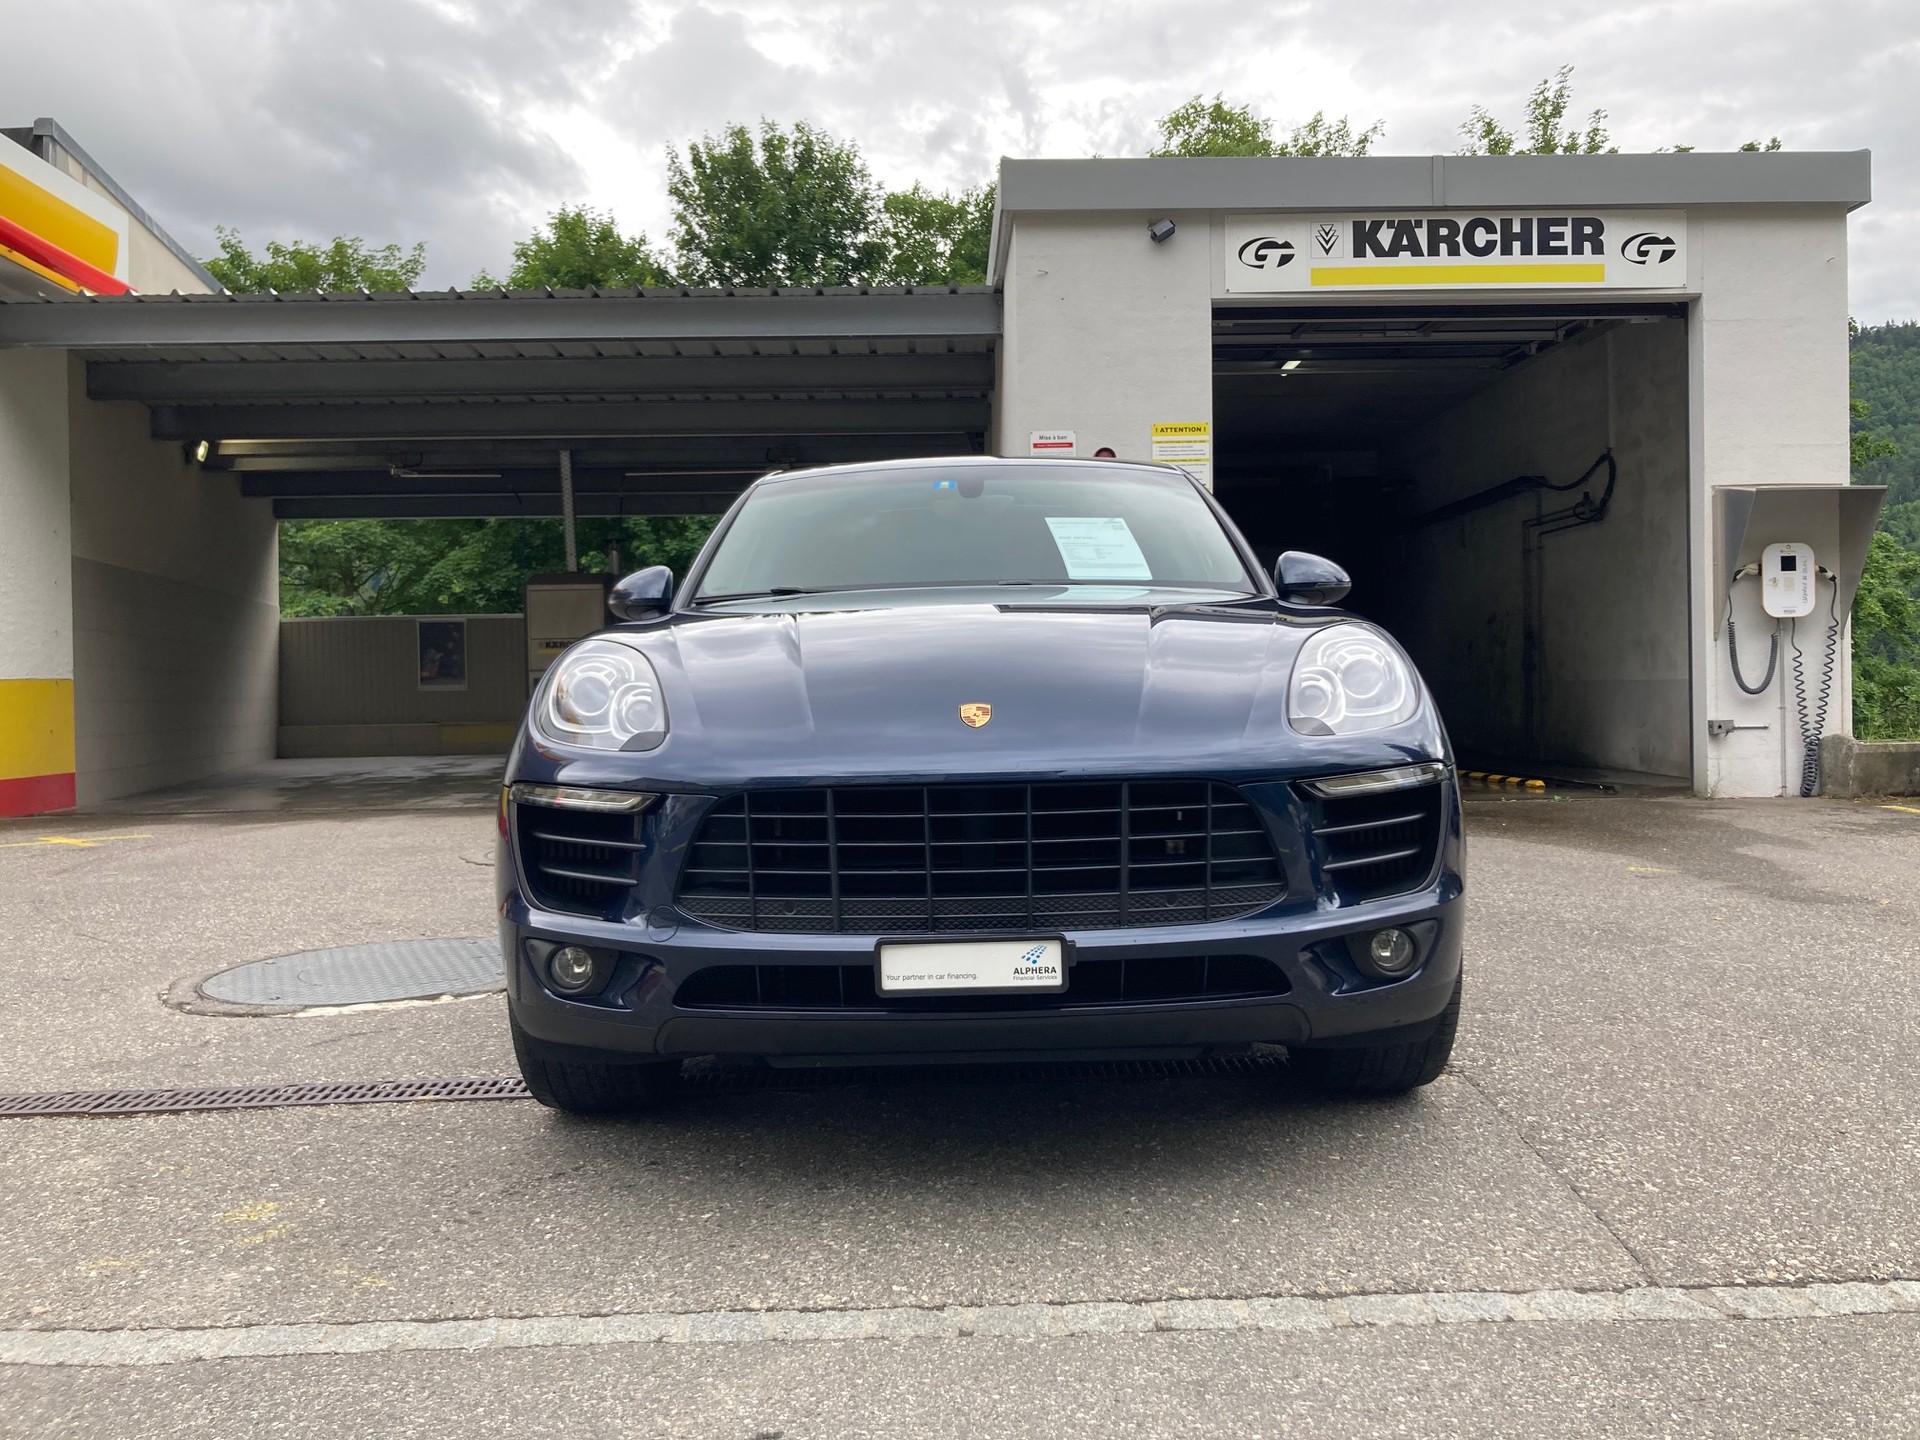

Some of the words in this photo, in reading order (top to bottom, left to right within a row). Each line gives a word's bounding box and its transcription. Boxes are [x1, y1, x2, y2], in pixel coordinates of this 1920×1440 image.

[1353, 217, 1605, 258] KÄRCHER
[1013, 966, 1057, 975] ALPHERA
[902, 973, 926, 982] partner
[947, 972, 979, 981] financing.
